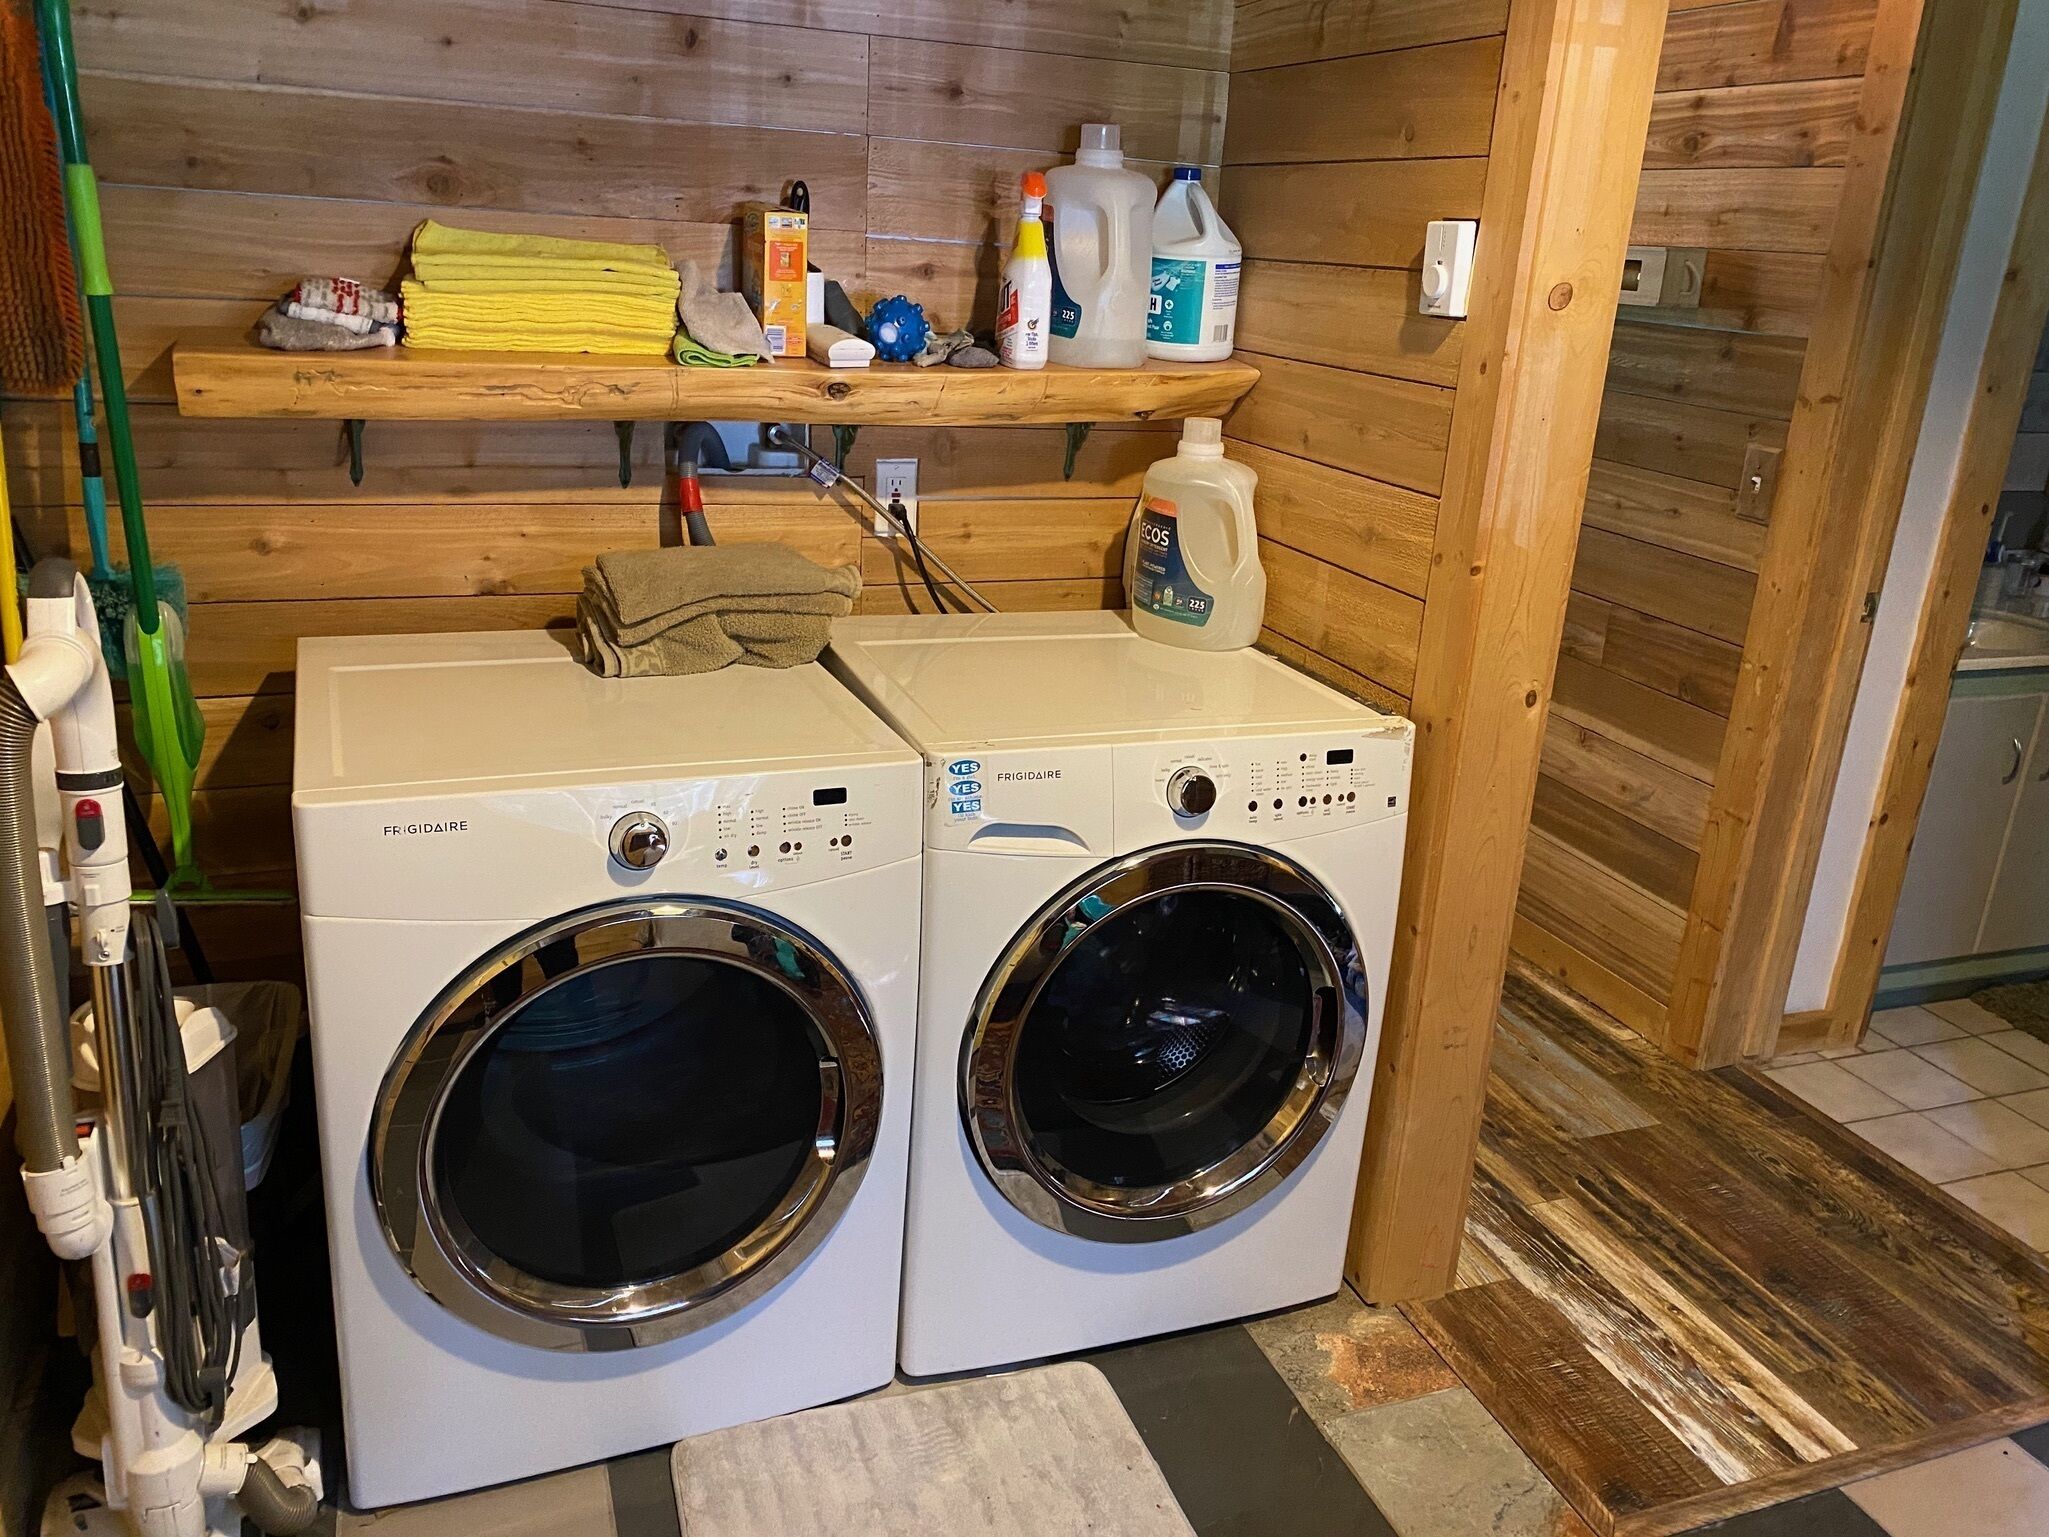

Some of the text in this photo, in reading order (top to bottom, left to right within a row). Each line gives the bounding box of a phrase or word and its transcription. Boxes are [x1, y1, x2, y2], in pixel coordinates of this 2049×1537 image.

[1062, 309, 1075, 320] 225
[1141, 521, 1170, 547] ECOS
[1189, 599, 1205, 610] 225
[952, 762, 979, 774] YES
[997, 769, 1062, 782] FRIGIDAIRE
[954, 782, 980, 794] YES
[953, 801, 981, 812] YES
[383, 820, 468, 836] FRIGIDAIRE
